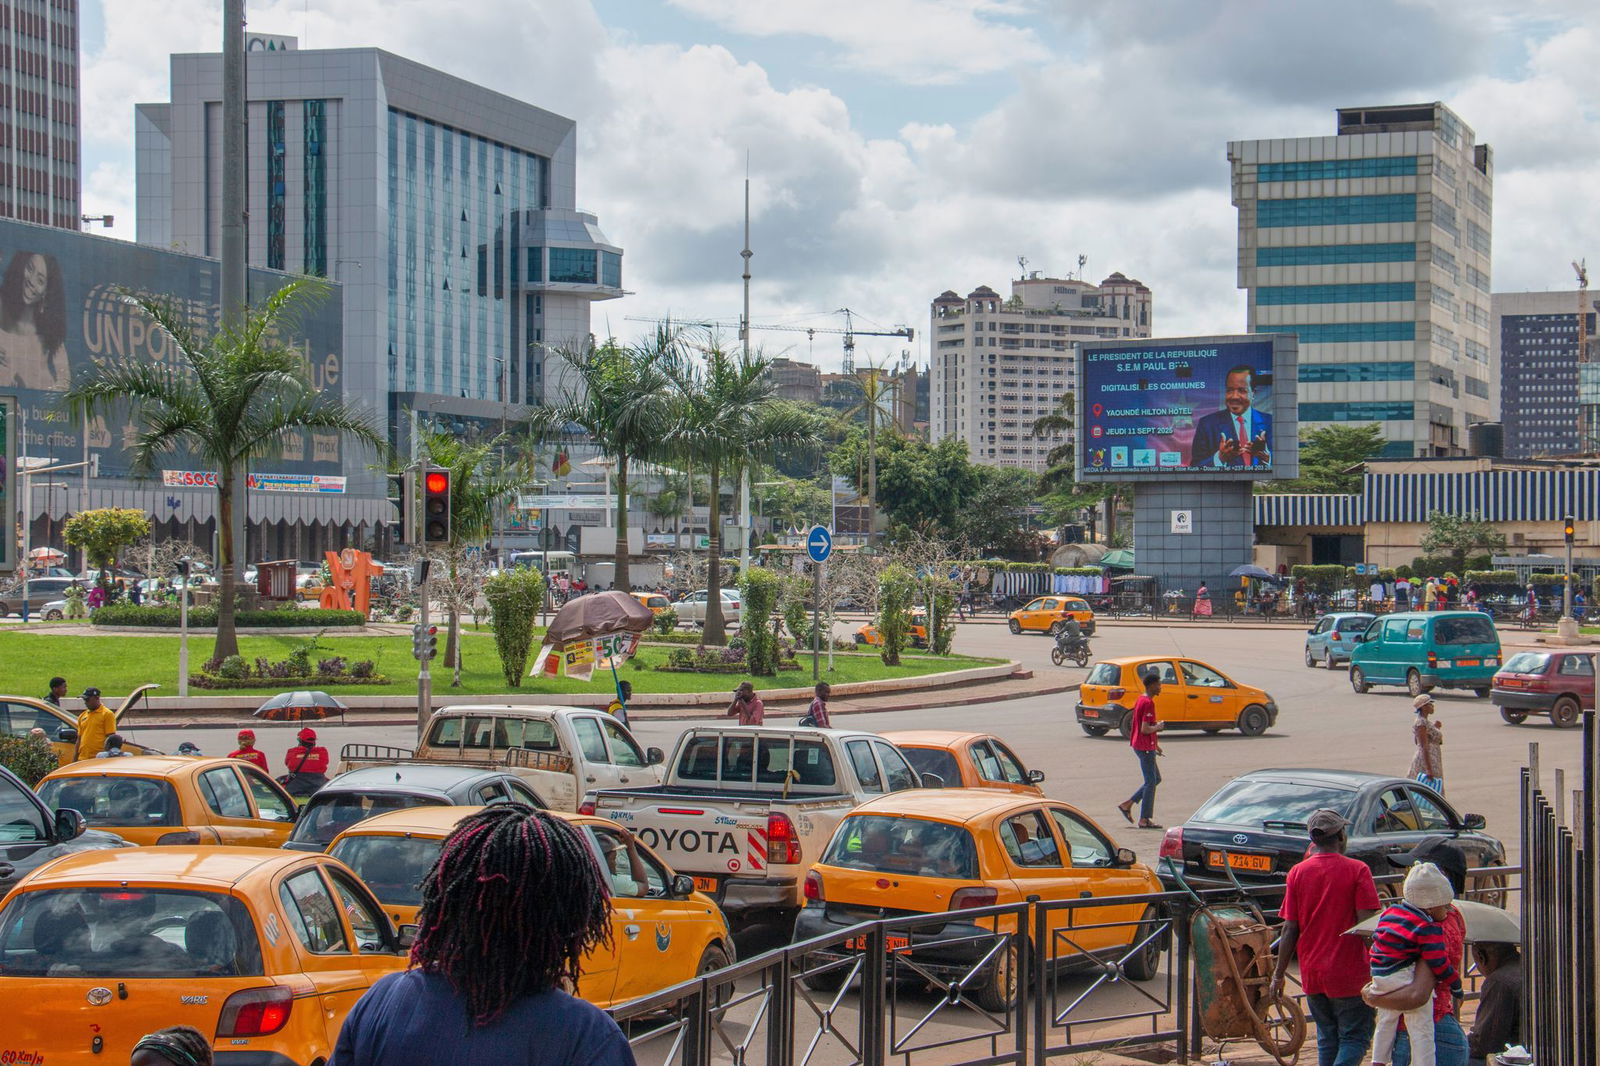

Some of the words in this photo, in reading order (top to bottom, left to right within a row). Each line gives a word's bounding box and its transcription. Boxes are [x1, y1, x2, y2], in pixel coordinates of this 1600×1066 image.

[1087, 354, 1099, 362] LE
[1099, 352, 1142, 361] PRESIDENT
[1156, 351, 1166, 359] LA
[1167, 349, 1217, 358] REPUBLIQUE
[1117, 363, 1141, 372] S.E.M
[1143, 362, 1166, 371] PAUL
[1101, 383, 1140, 392] DIGITALIS
[1160, 381, 1205, 390] COMMUNES
[1106, 408, 1139, 417] YAOUNDÉ
[1141, 408, 1168, 416] HILTON
[1137, 427, 1156, 435] SEPT
[316, 441, 336, 454] max
[697, 878, 710, 891] JN
[181, 995, 208, 1005] YARIS
[1, 1049, 17, 1064] 60
